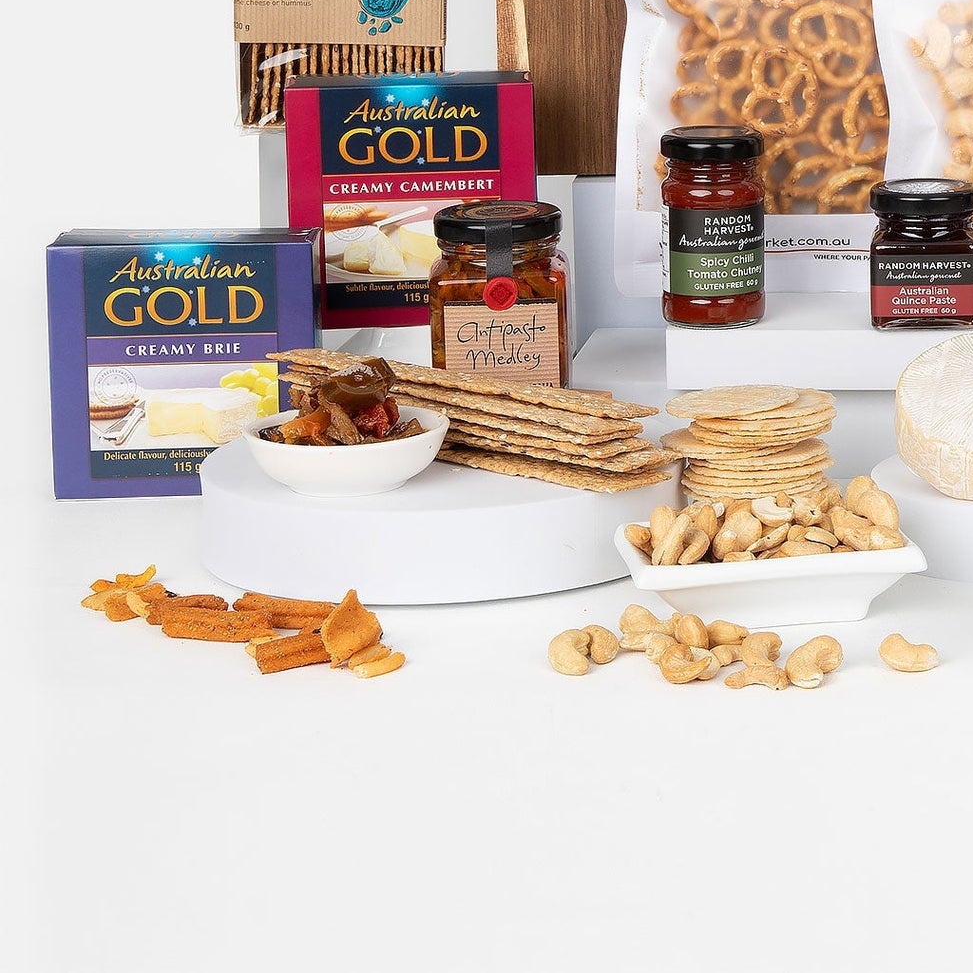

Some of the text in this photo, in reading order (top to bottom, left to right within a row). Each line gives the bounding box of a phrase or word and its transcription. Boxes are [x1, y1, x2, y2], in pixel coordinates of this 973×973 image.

[343, 95, 480, 125] Australian
[338, 125, 488, 166] GOLD
[329, 179, 494, 195] CREAMY CAMEMBERT
[704, 214, 751, 226] RANDOM
[679, 234, 738, 248] Australian
[766, 237, 851, 248] rket.com.au
[700, 253, 754, 268] Spicy Chilli
[878, 262, 921, 270] RANDOM
[109, 254, 256, 283] Australian
[687, 264, 763, 279] Tomato Chutney
[346, 283, 368, 292] Subtle
[397, 281, 429, 290] deliciousl
[694, 282, 724, 290] GLUTEN
[726, 280, 744, 289] FREE
[899, 286, 949, 296] Australian
[404, 292, 430, 304] 115 g
[891, 296, 957, 305] Quince Paste
[103, 285, 264, 327] GOLD
[125, 342, 241, 356] CREAMY BRIE
[103, 451, 136, 461] Delicate
[138, 450, 168, 460] flavour,
[174, 461, 192, 472] 115
